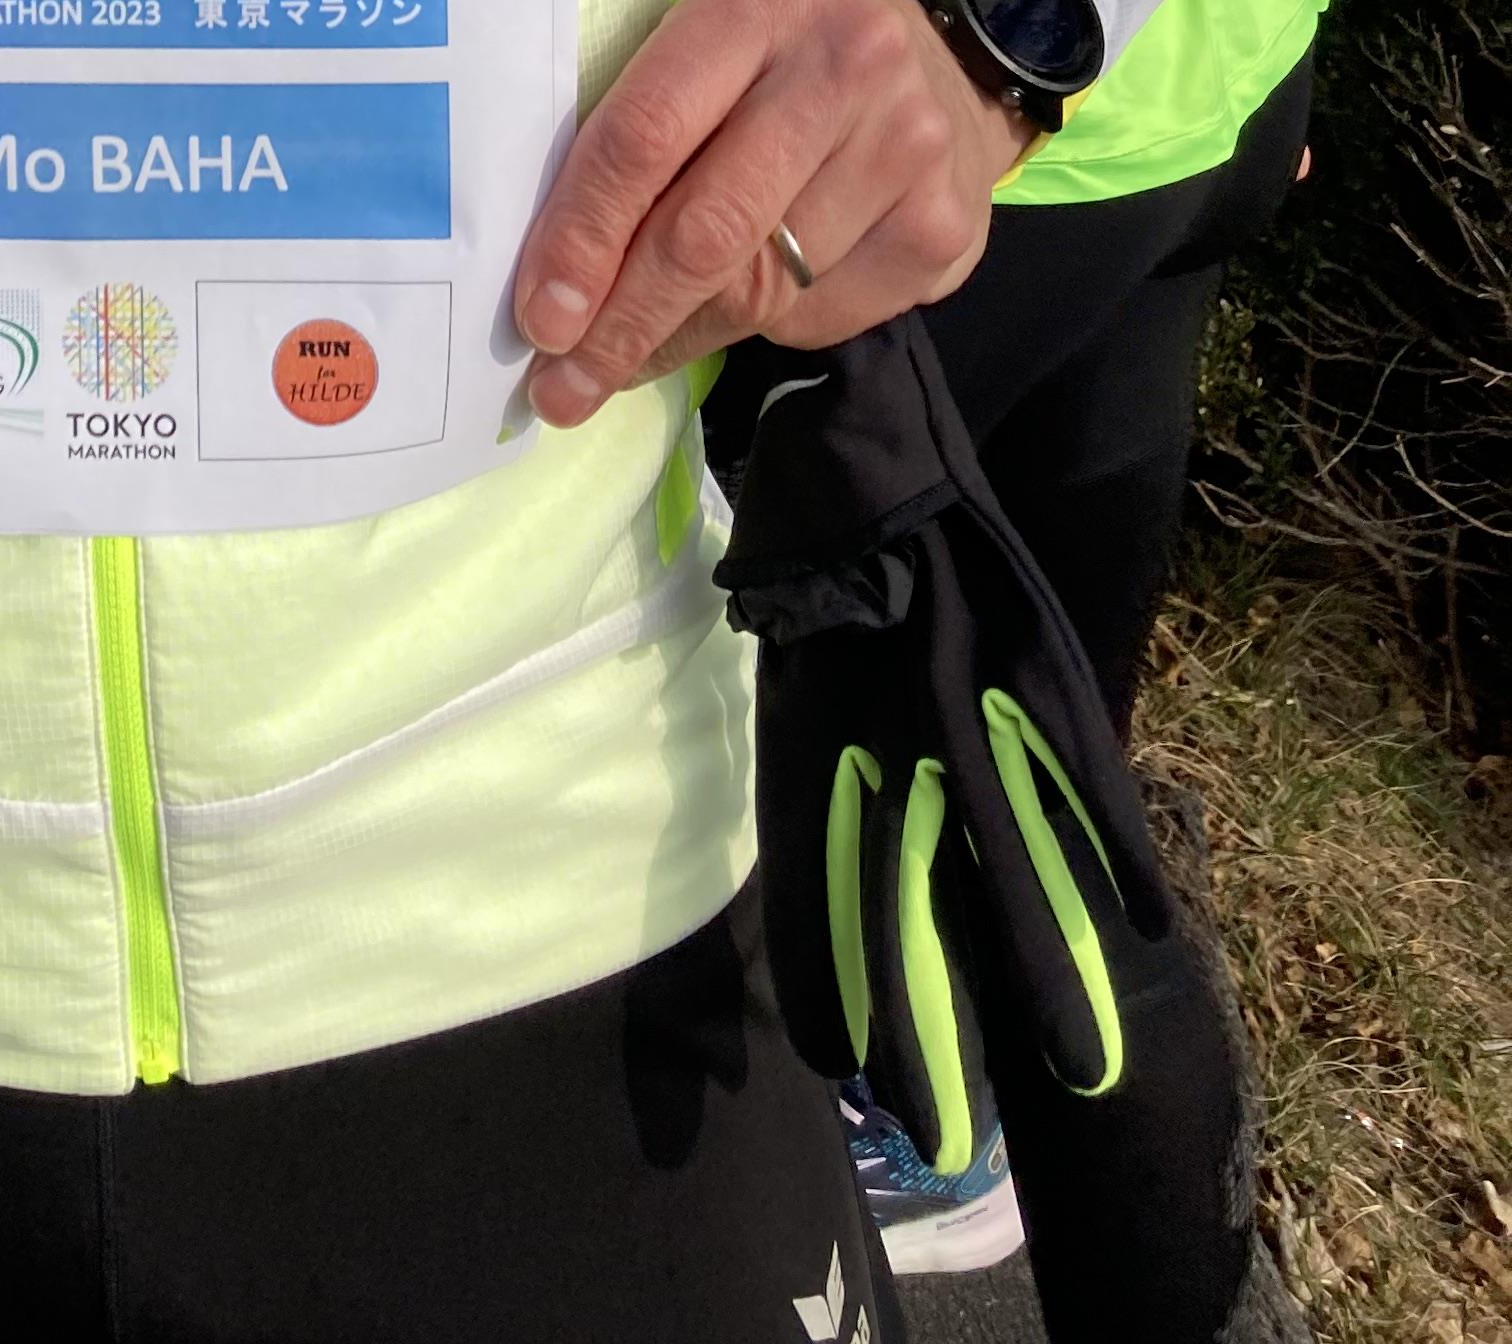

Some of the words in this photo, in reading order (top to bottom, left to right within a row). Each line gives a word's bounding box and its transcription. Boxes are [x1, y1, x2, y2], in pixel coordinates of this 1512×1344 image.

[92, 134, 288, 193] BAHA
[299, 340, 351, 358] RUN
[317, 365, 337, 382] for
[288, 382, 366, 404] HILDE
[66, 413, 177, 438] TOKYO
[68, 444, 176, 460] MARATHON
